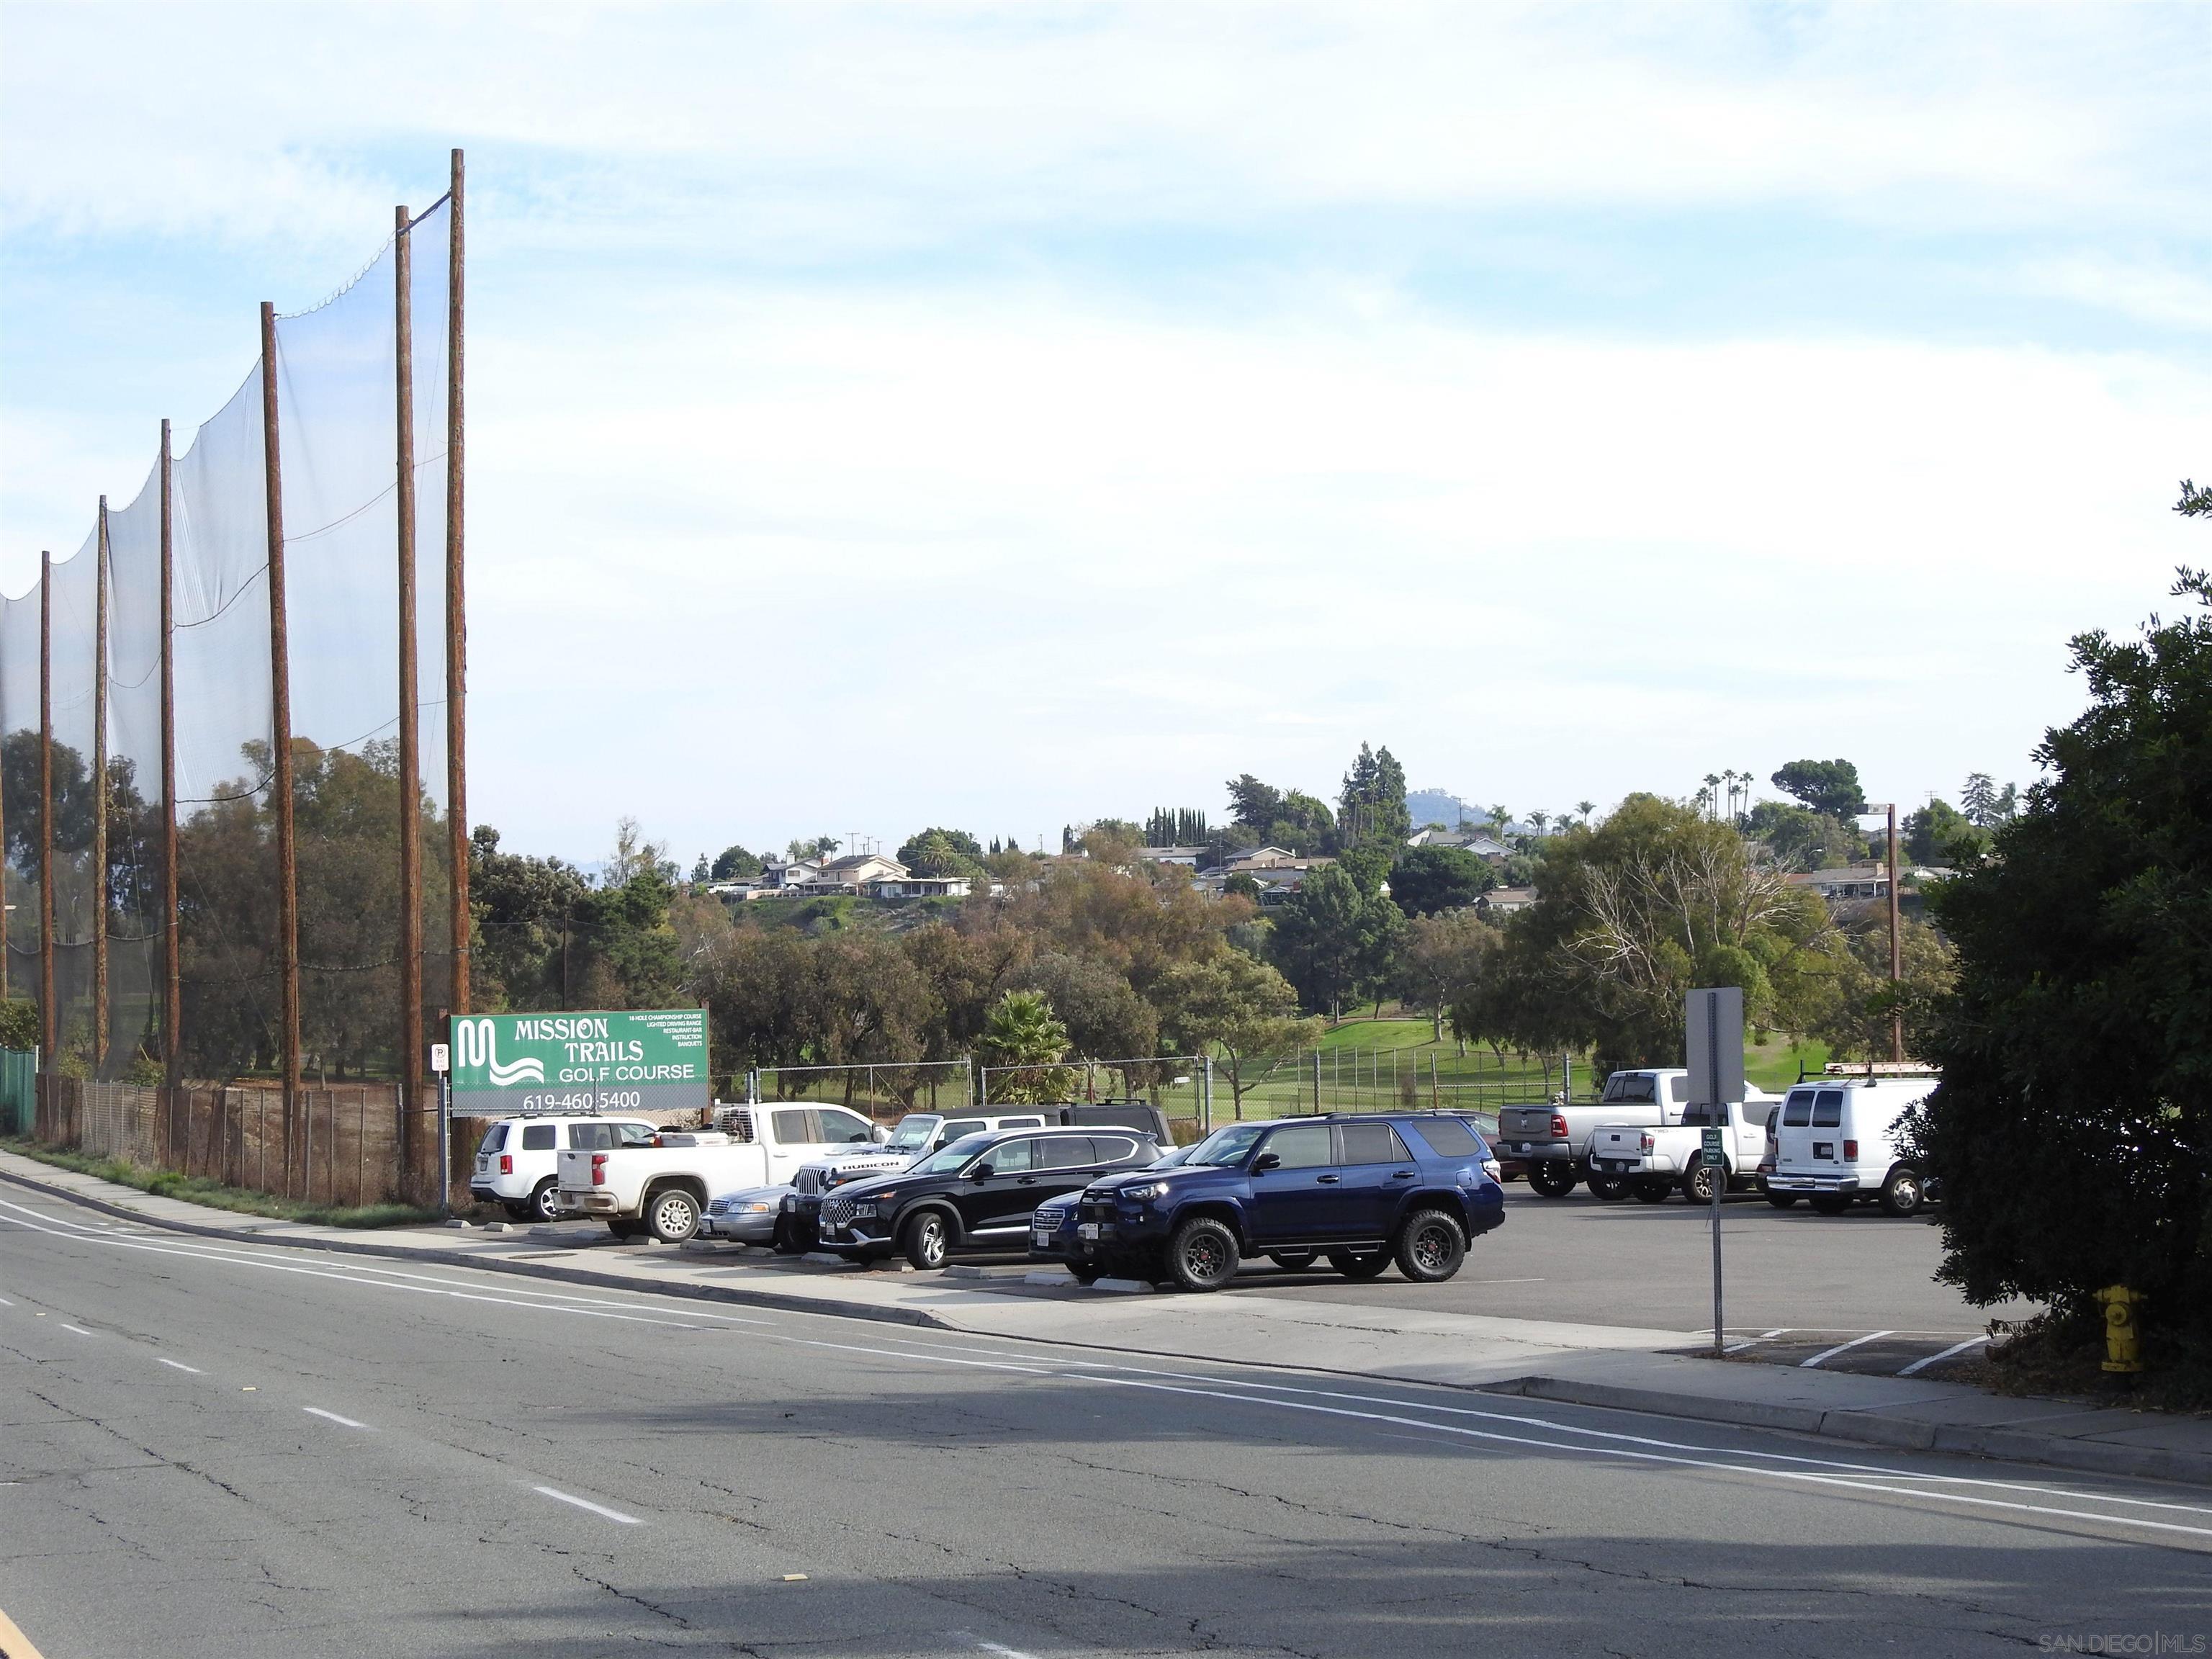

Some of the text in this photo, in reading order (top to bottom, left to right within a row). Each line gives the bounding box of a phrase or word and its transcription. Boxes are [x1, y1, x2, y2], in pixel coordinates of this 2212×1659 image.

[515, 1017, 609, 1040] MISSION
[565, 1040, 644, 1063] TRAILS
[559, 1064, 695, 1082] GOLF COURSE
[523, 1091, 640, 1110] 619-460-5400
[842, 1161, 899, 1170] RUBICON
